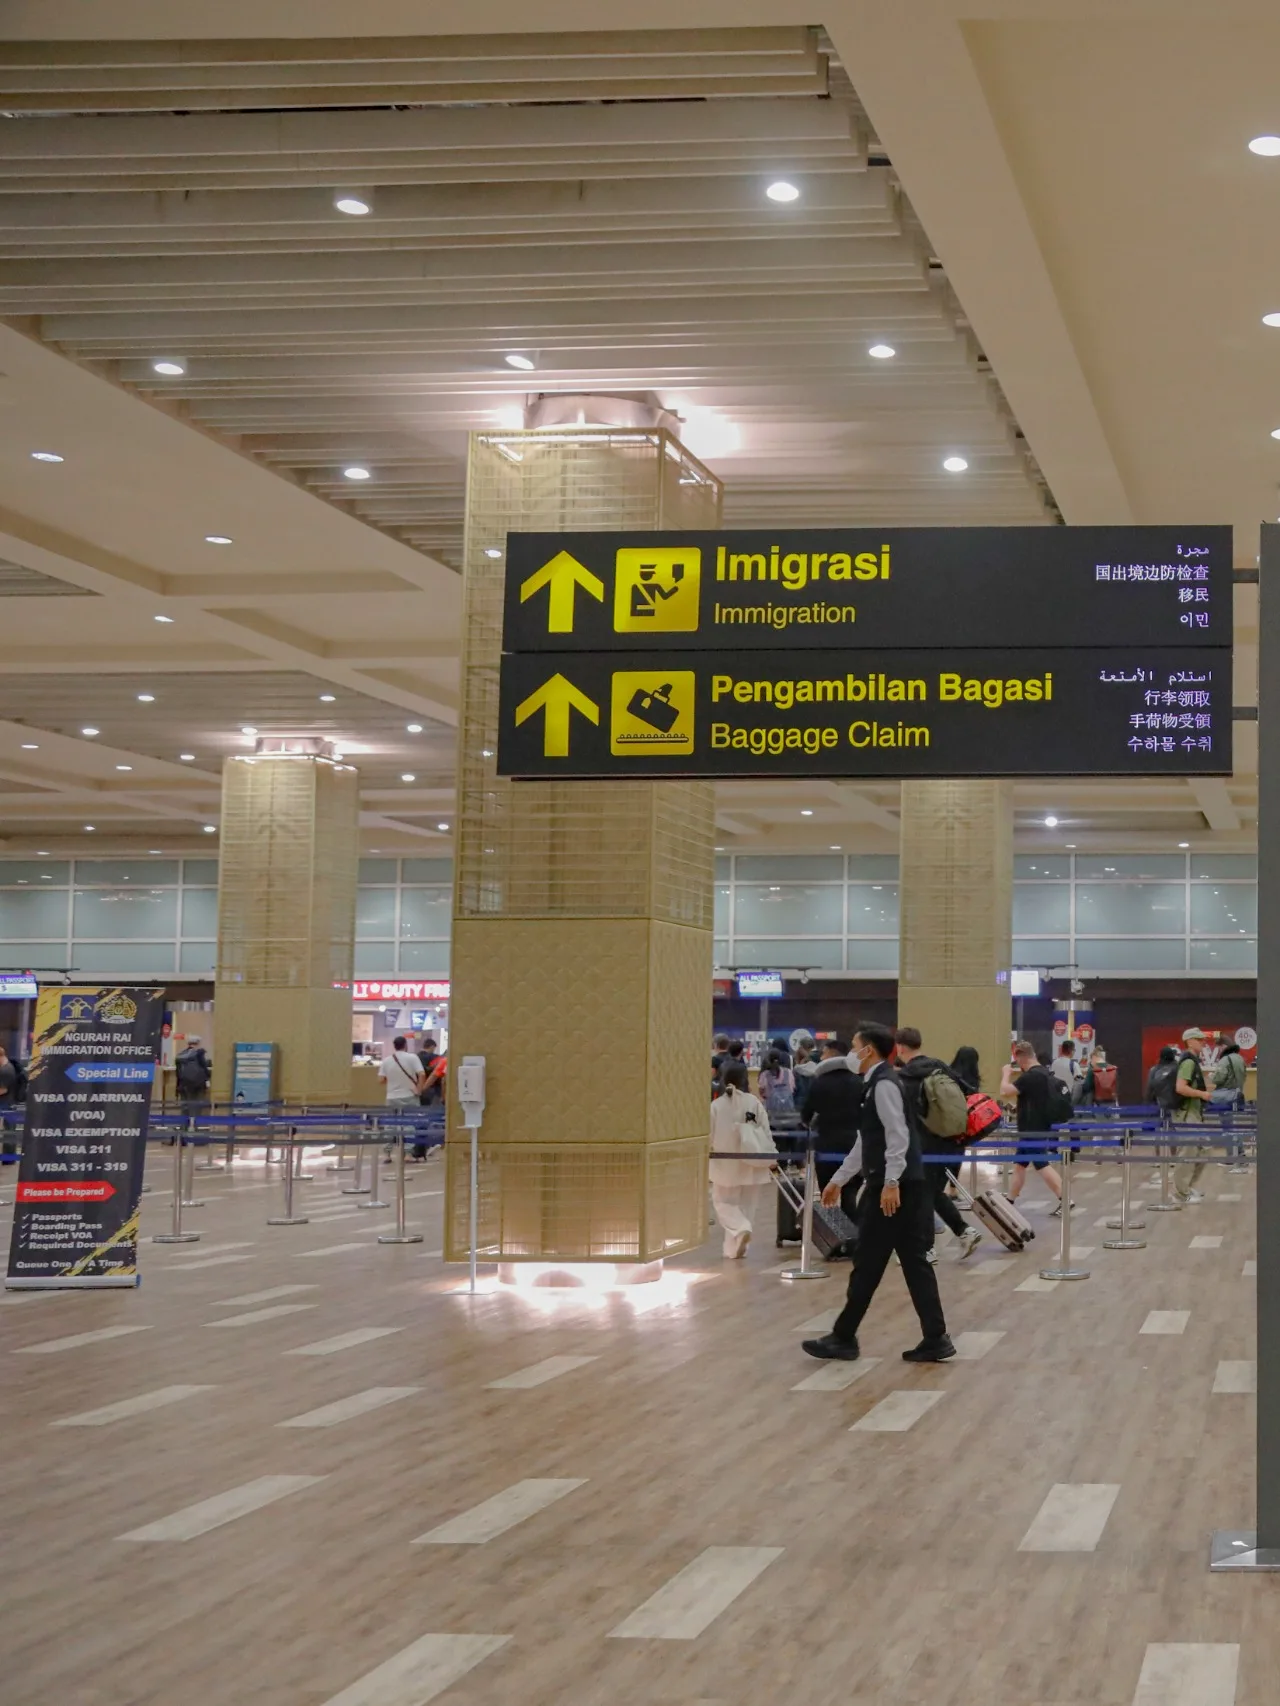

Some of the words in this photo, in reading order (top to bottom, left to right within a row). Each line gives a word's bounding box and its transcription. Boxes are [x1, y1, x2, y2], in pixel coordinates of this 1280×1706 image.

[716, 545, 890, 590] Imigrasi
[1096, 564, 1209, 581] 国出境边防检查
[1178, 587, 1209, 603] 移民
[715, 602, 856, 630] Immigration
[1180, 612, 1209, 628] 이민
[712, 673, 927, 710] Pengambilan
[939, 672, 1052, 708] Bagasi
[1145, 689, 1211, 707] 行李领取
[1129, 713, 1211, 729] 手荷物受領
[711, 722, 839, 755] Baggage
[848, 720, 930, 747] Claim
[1127, 735, 1176, 752] 수하물
[1181, 735, 1212, 752] 수취
[382, 984, 422, 998] DUTY
[424, 984, 450, 998] FRE
[65, 1033, 110, 1042] NGURAH
[113, 1033, 131, 1042] RAI
[41, 1046, 111, 1055] IMMIGRATION
[114, 1046, 152, 1055] OFFICE
[77, 1068, 120, 1079] Special
[124, 1068, 148, 1078] Line
[34, 1094, 65, 1102] VISA
[68, 1094, 87, 1102] ON
[92, 1094, 145, 1102] ARRIVAL
[70, 1110, 105, 1121] (VOA)
[31, 1128, 62, 1137] VISA
[66, 1128, 140, 1136] EXEMPTION
[56, 1145, 87, 1154] VISA
[89, 1145, 111, 1153] 211
[37, 1163, 68, 1172] VISA
[71, 1163, 92, 1171] 311
[104, 1163, 128, 1171] 319
[24, 1188, 51, 1196] Please
[66, 1188, 104, 1197] Prepared
[31, 1223, 77, 1231] Boarding
[30, 1232, 69, 1240] Receipt
[29, 1242, 74, 1250] Required
[16, 1261, 48, 1269] Queue
[99, 1260, 124, 1268] Time
